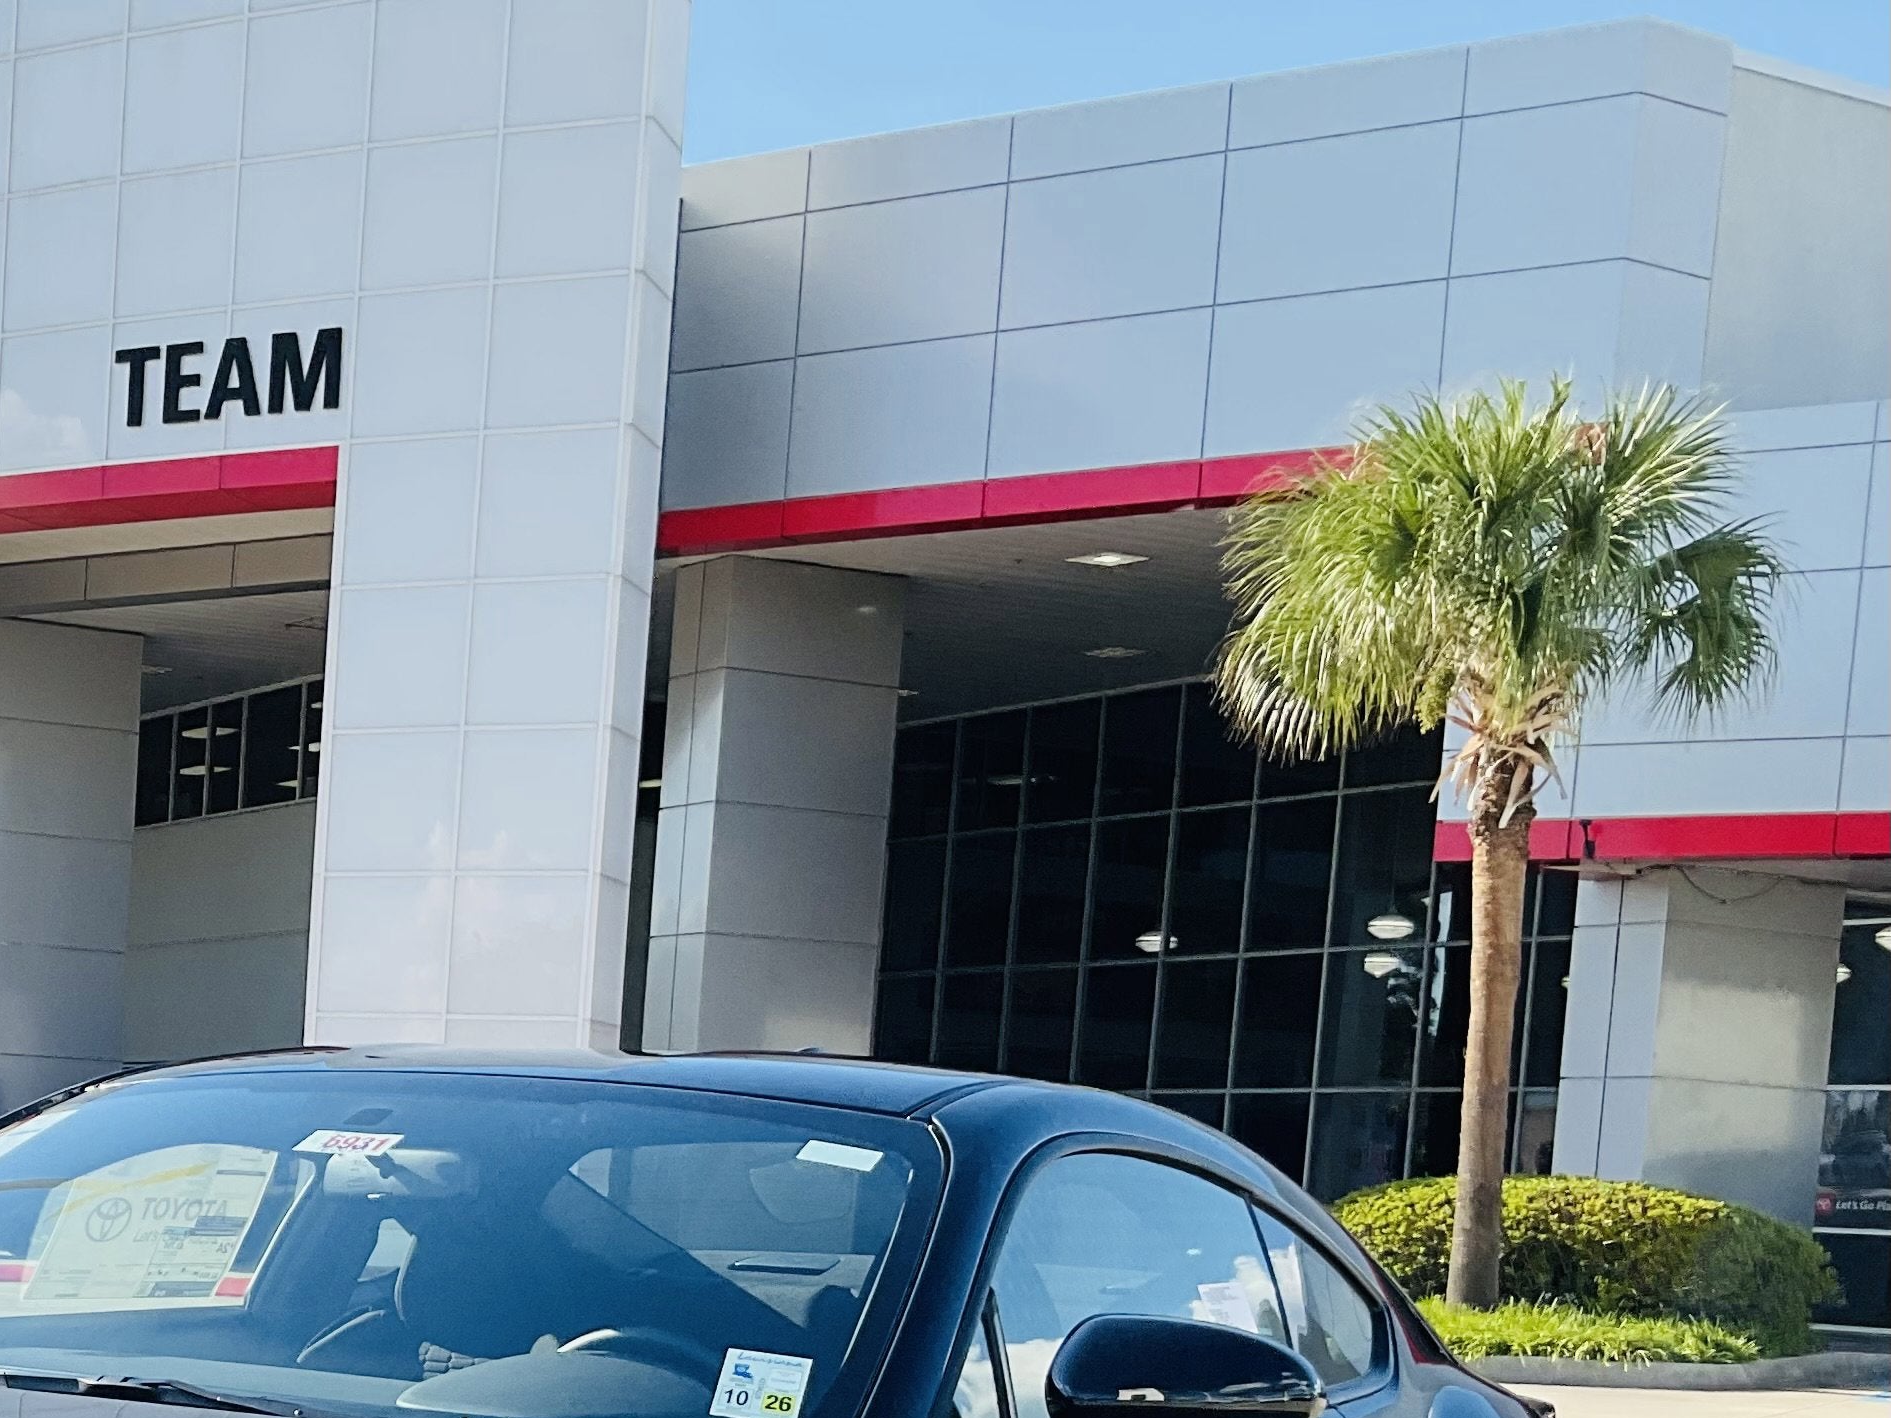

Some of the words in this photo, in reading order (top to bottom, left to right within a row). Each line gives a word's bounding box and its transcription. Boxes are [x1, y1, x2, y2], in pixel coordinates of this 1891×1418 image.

[114, 326, 343, 428] TEAM
[141, 1197, 228, 1221] TOYOTA
[724, 1388, 749, 1406] 10
[764, 1394, 792, 1412] 26
